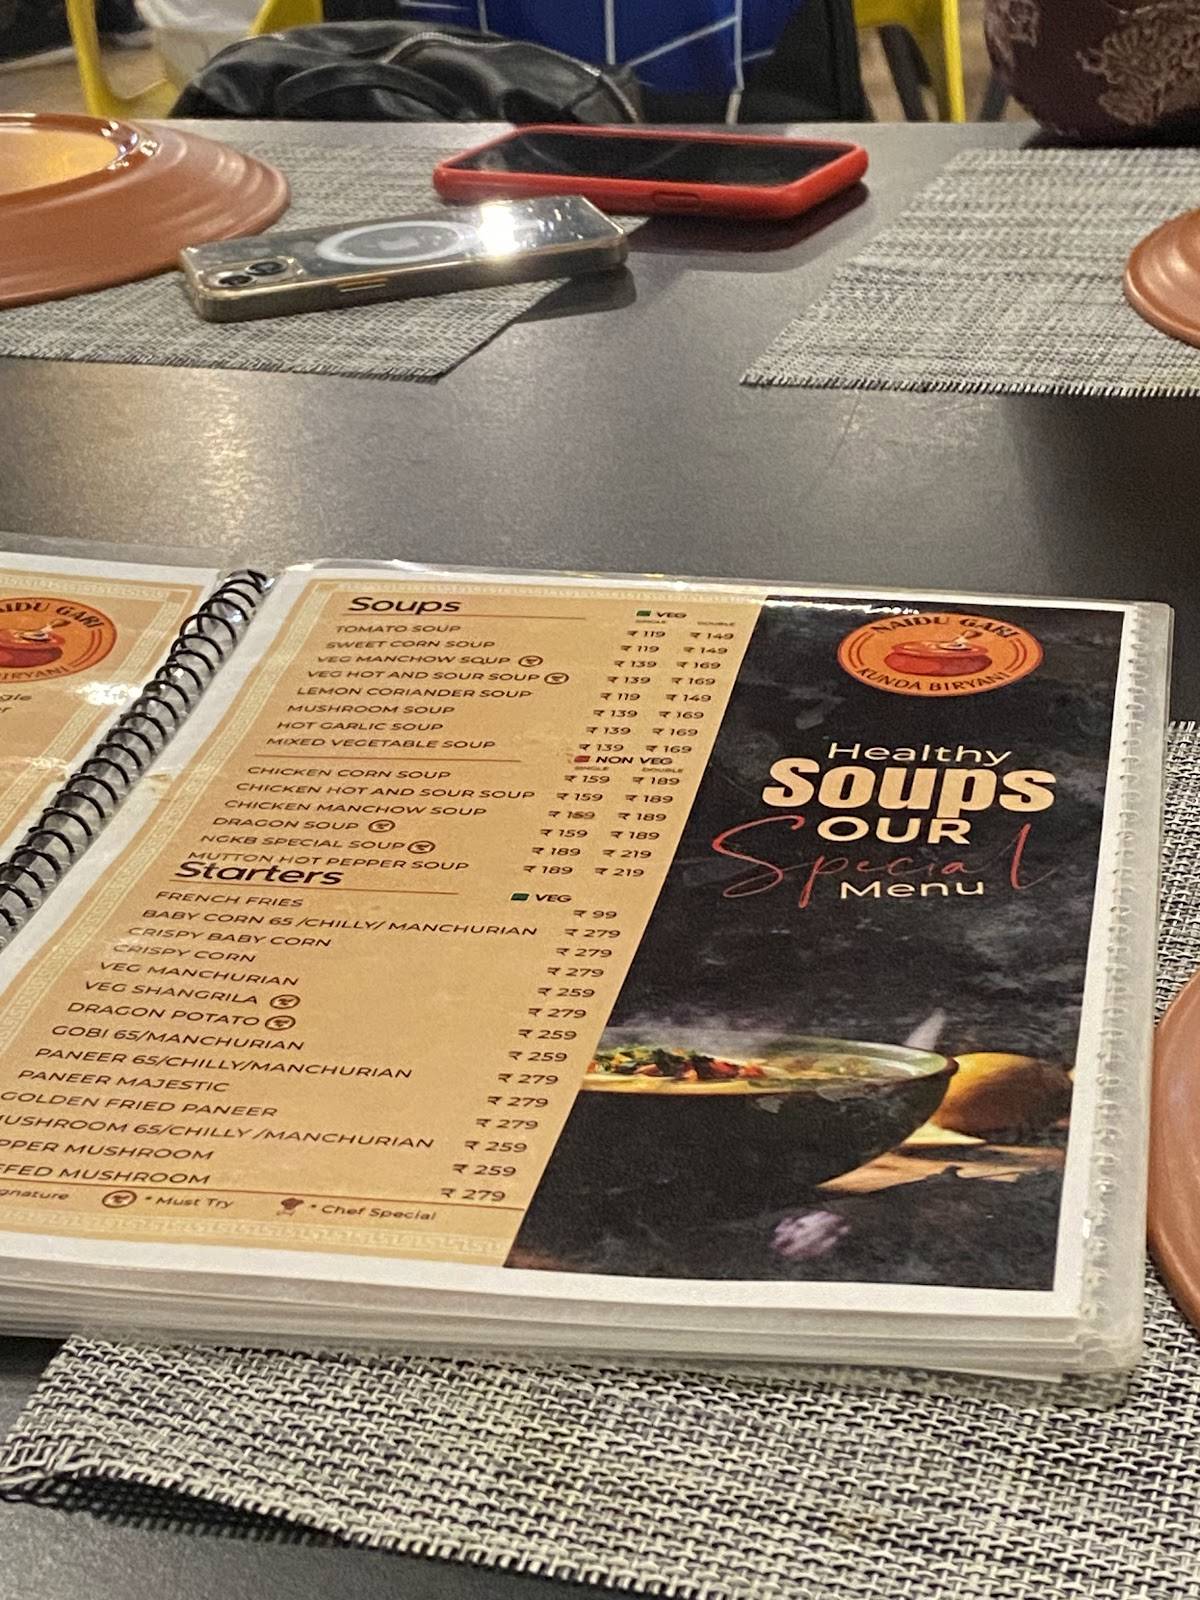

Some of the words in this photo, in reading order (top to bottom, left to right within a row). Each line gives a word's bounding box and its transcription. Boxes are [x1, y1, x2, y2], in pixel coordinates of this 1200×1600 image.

[0, 602, 50, 612] IDU
[56, 606, 104, 628] GARI
[348, 596, 462, 615] Soups
[336, 624, 407, 633] TOMATO
[411, 625, 461, 633] SOUP
[870, 616, 950, 634] NAIDU
[959, 618, 1022, 639] GARI
[326, 640, 385, 649] SWEET
[390, 640, 440, 649] CORN
[445, 640, 496, 649] SOUP
[318, 656, 351, 664] VEG
[356, 656, 456, 664] MANCHOW
[0, 666, 68, 680] IRYANI
[308, 670, 344, 678] VEG
[346, 670, 385, 679] HOT
[391, 671, 429, 680] AND
[434, 672, 485, 680] SOUR
[488, 673, 540, 682] SOUP
[929, 672, 1013, 692] BIRYANI
[297, 687, 362, 696] LEMON
[366, 688, 476, 698] CORIANDER
[480, 689, 532, 699] SOUP
[287, 704, 398, 714] MUSHROOM
[403, 705, 456, 714] SOUP
[276, 722, 316, 730] HOT
[320, 722, 388, 731] GARLIC
[391, 722, 444, 732] SOUP
[266, 738, 326, 746] MIXED
[331, 738, 438, 748] VEGETABLE
[442, 740, 496, 749] SOUP
[596, 756, 634, 764] NON
[827, 742, 1012, 767] Healthy
[248, 766, 332, 776] CHICKEN
[338, 768, 392, 778] CORN
[396, 770, 452, 780] SOUP
[236, 783, 322, 794] CHICKEN
[326, 786, 368, 794] HOT
[370, 787, 415, 797] AND
[420, 788, 476, 798] SOUR
[478, 790, 536, 800] SOUP
[761, 757, 1057, 818] Soups
[224, 800, 311, 812] CHICKEN
[316, 803, 427, 814] MANCHOW
[430, 806, 487, 816] SOUP
[212, 817, 300, 828] DRAGON
[304, 820, 360, 830] SOUP
[816, 816, 972, 846] OUR
[200, 835, 258, 845] NGKB
[262, 836, 342, 848] SPECIAL
[349, 840, 406, 850] SOUP
[188, 852, 274, 864] MUTTON
[279, 855, 322, 866] HOT
[326, 858, 406, 869] PEPPER
[412, 860, 470, 871] SOUP
[711, 814, 1059, 908] Special
[175, 861, 346, 886] Starters
[156, 891, 241, 904] FRENCH
[246, 896, 304, 908] FRIES
[536, 894, 572, 902] VEG
[839, 880, 984, 900] Menu
[142, 910, 202, 920] BABY
[204, 913, 265, 924] CORN
[270, 916, 294, 926] 65
[388, 920, 537, 936] MANCHURIAN
[128, 927, 204, 940] CRISPY
[208, 932, 268, 944] BABY
[270, 936, 332, 948] CORN
[113, 944, 190, 957] CRISPY
[194, 950, 256, 962] CORN
[100, 962, 140, 972] VEG
[147, 966, 299, 986] MANCHURIAN
[85, 981, 126, 992] VEG
[131, 984, 258, 1004] SHANGRILA
[67, 1002, 166, 1018] DRAGON
[171, 1010, 260, 1026] POTATO
[51, 1026, 109, 1039] GOBI
[113, 1029, 304, 1051] 65/MANCHURIAN
[35, 1048, 128, 1064] PANEER
[132, 1054, 412, 1079] 65/CHILLY/MANCHURIAN
[17, 1069, 112, 1086] PANEER
[116, 1076, 230, 1092] MAJESTIC
[0, 1091, 101, 1108] GOLDEN
[104, 1098, 176, 1112] FRIED
[181, 1104, 279, 1118] PANEER
[0, 1114, 128, 1133] USHROOM
[64, 1143, 214, 1162] MUSHROOM
[58, 1168, 210, 1186] MUSHROOM
[156, 1196, 200, 1208] Must
[208, 1198, 234, 1209] Try
[322, 1204, 368, 1216] Chef
[369, 1207, 437, 1221] Special
